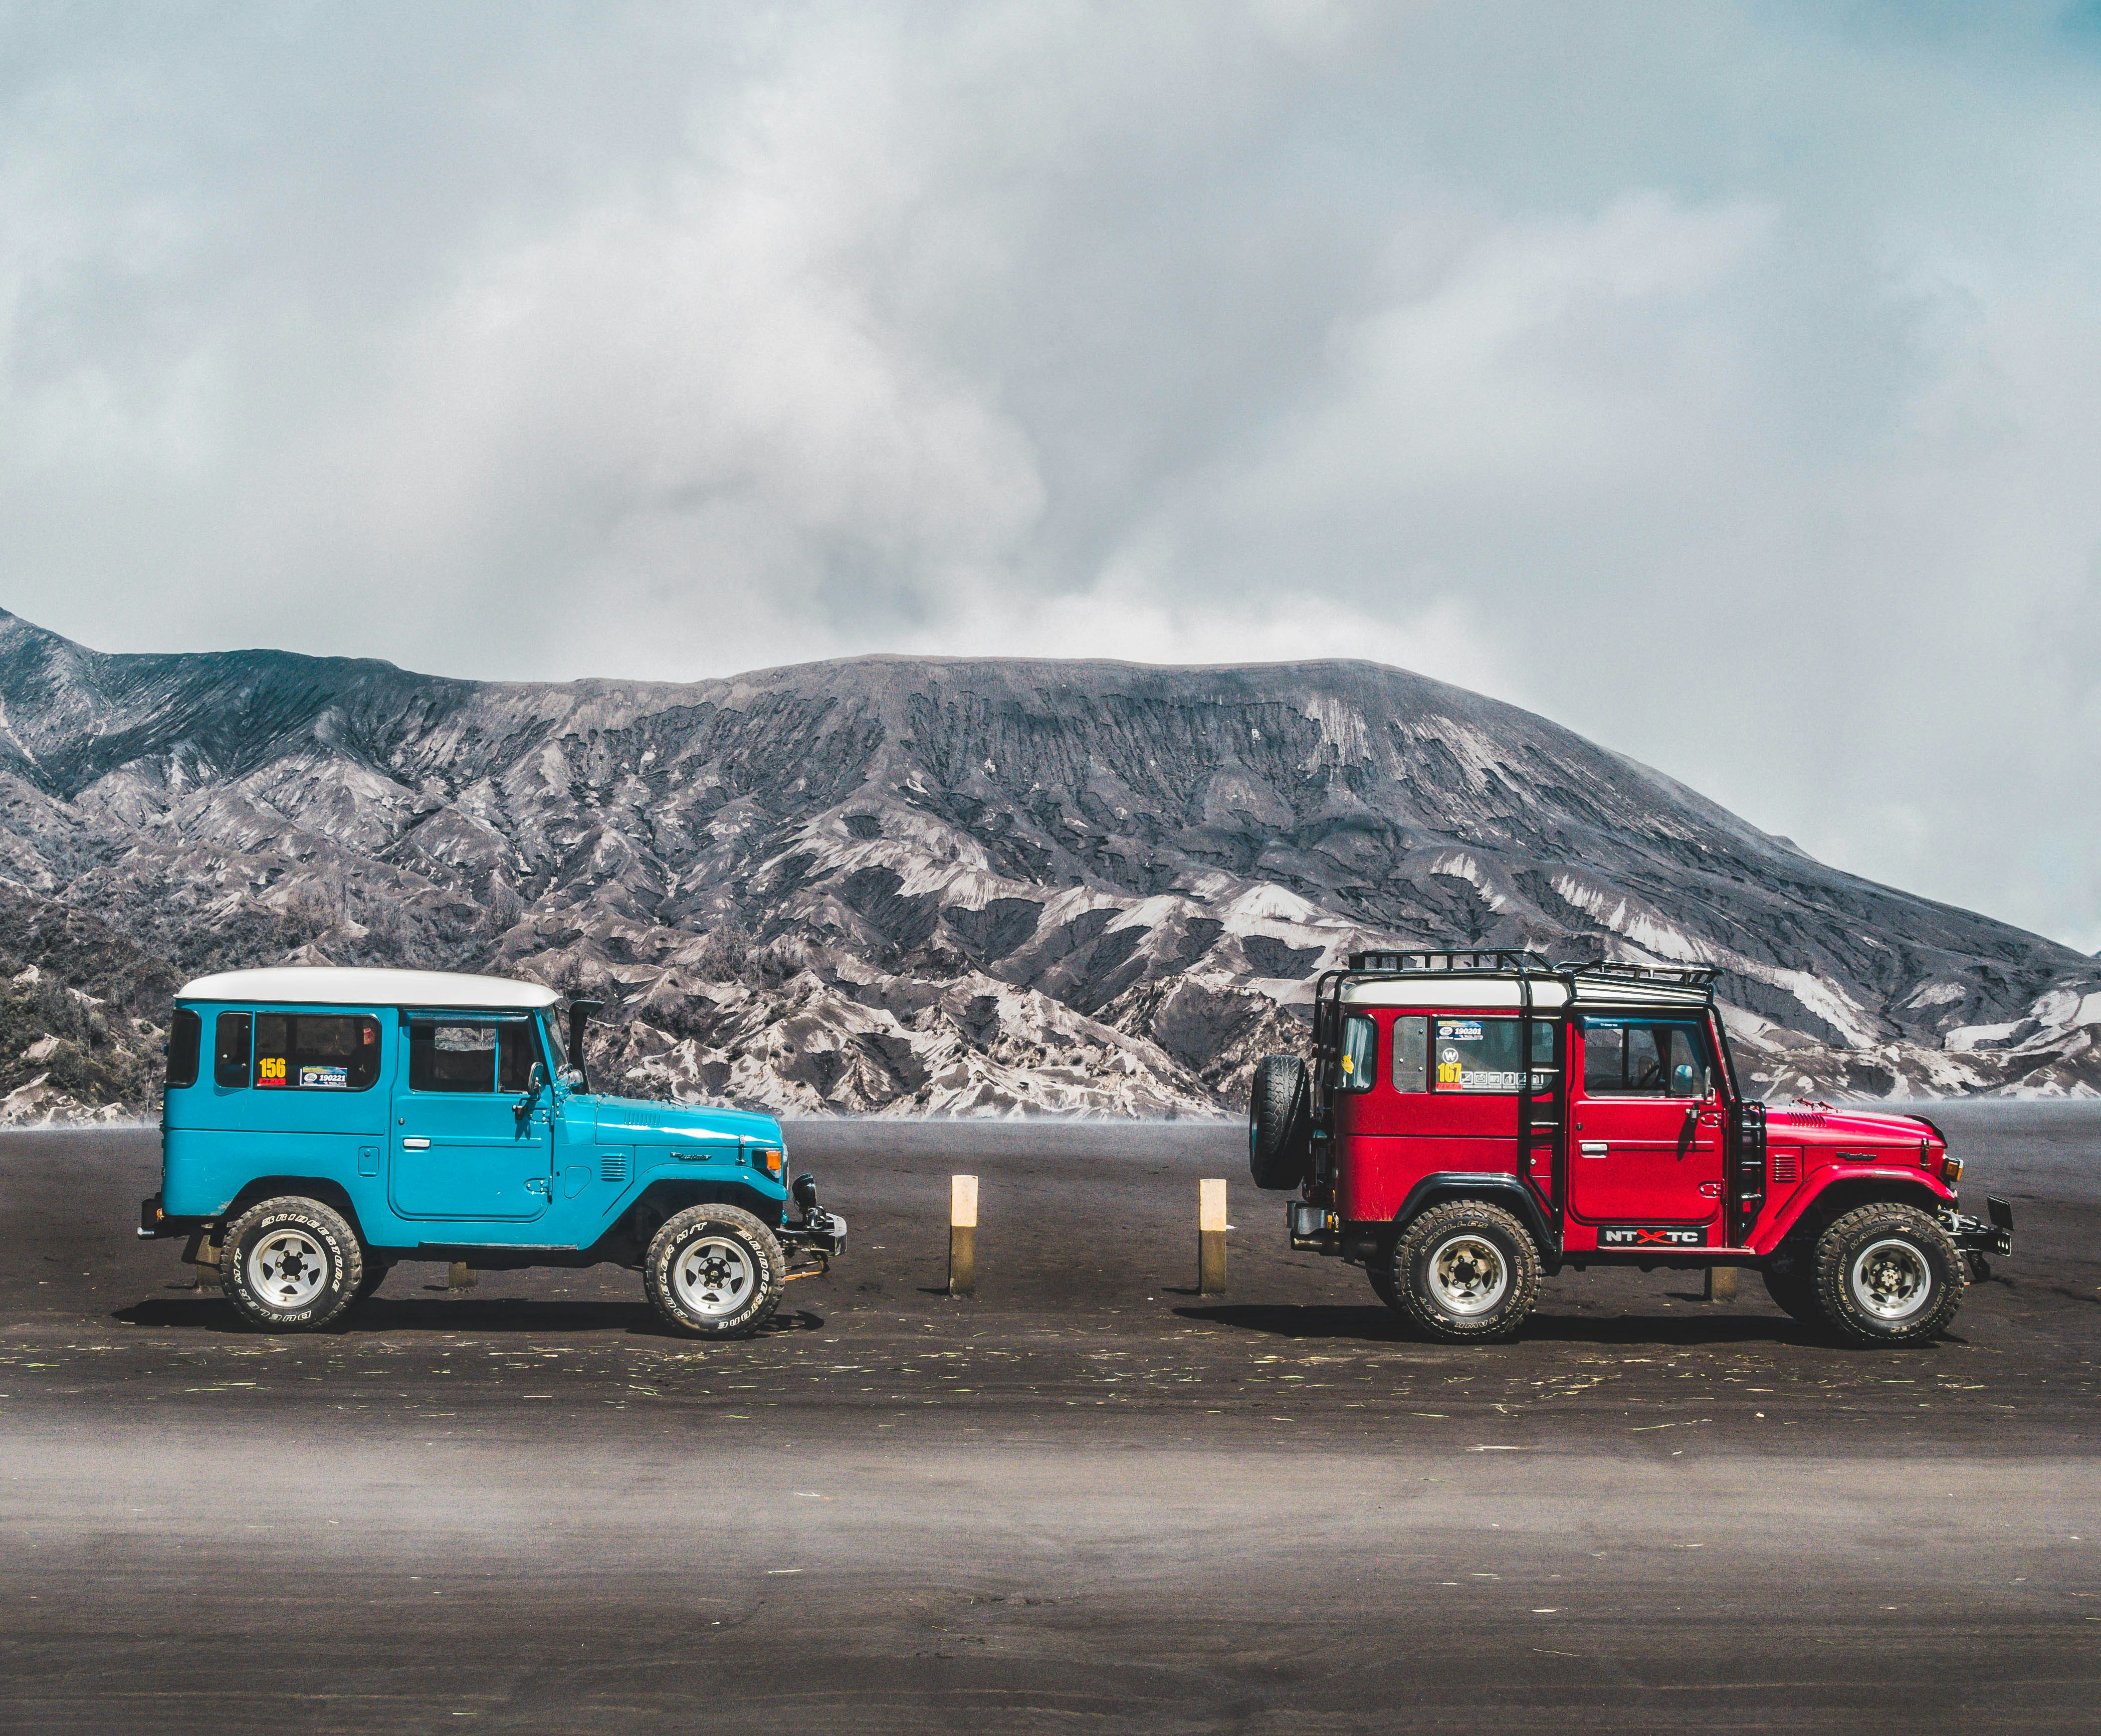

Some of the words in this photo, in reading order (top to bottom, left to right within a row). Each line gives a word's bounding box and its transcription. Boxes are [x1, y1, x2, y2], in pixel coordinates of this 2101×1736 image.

[259, 1058, 286, 1077] 156
[1438, 1063, 1461, 1082] 167
[261, 1213, 343, 1292] BRIDGESTONE
[1420, 1220, 1489, 1256] ACHILLES
[234, 1248, 242, 1283] M/T
[660, 1244, 688, 1319] DUELER
[677, 1222, 707, 1244] M/T
[718, 1230, 769, 1329] BRIDGESTONE
[1506, 1256, 1523, 1314] DESERT
[1838, 1253, 1854, 1312] DESERT
[1850, 1225, 1889, 1250] HAWK
[239, 1288, 312, 1322] DUELER
[1454, 1315, 1499, 1328] HAWK
[1889, 1282, 1946, 1333] ACHILLES
